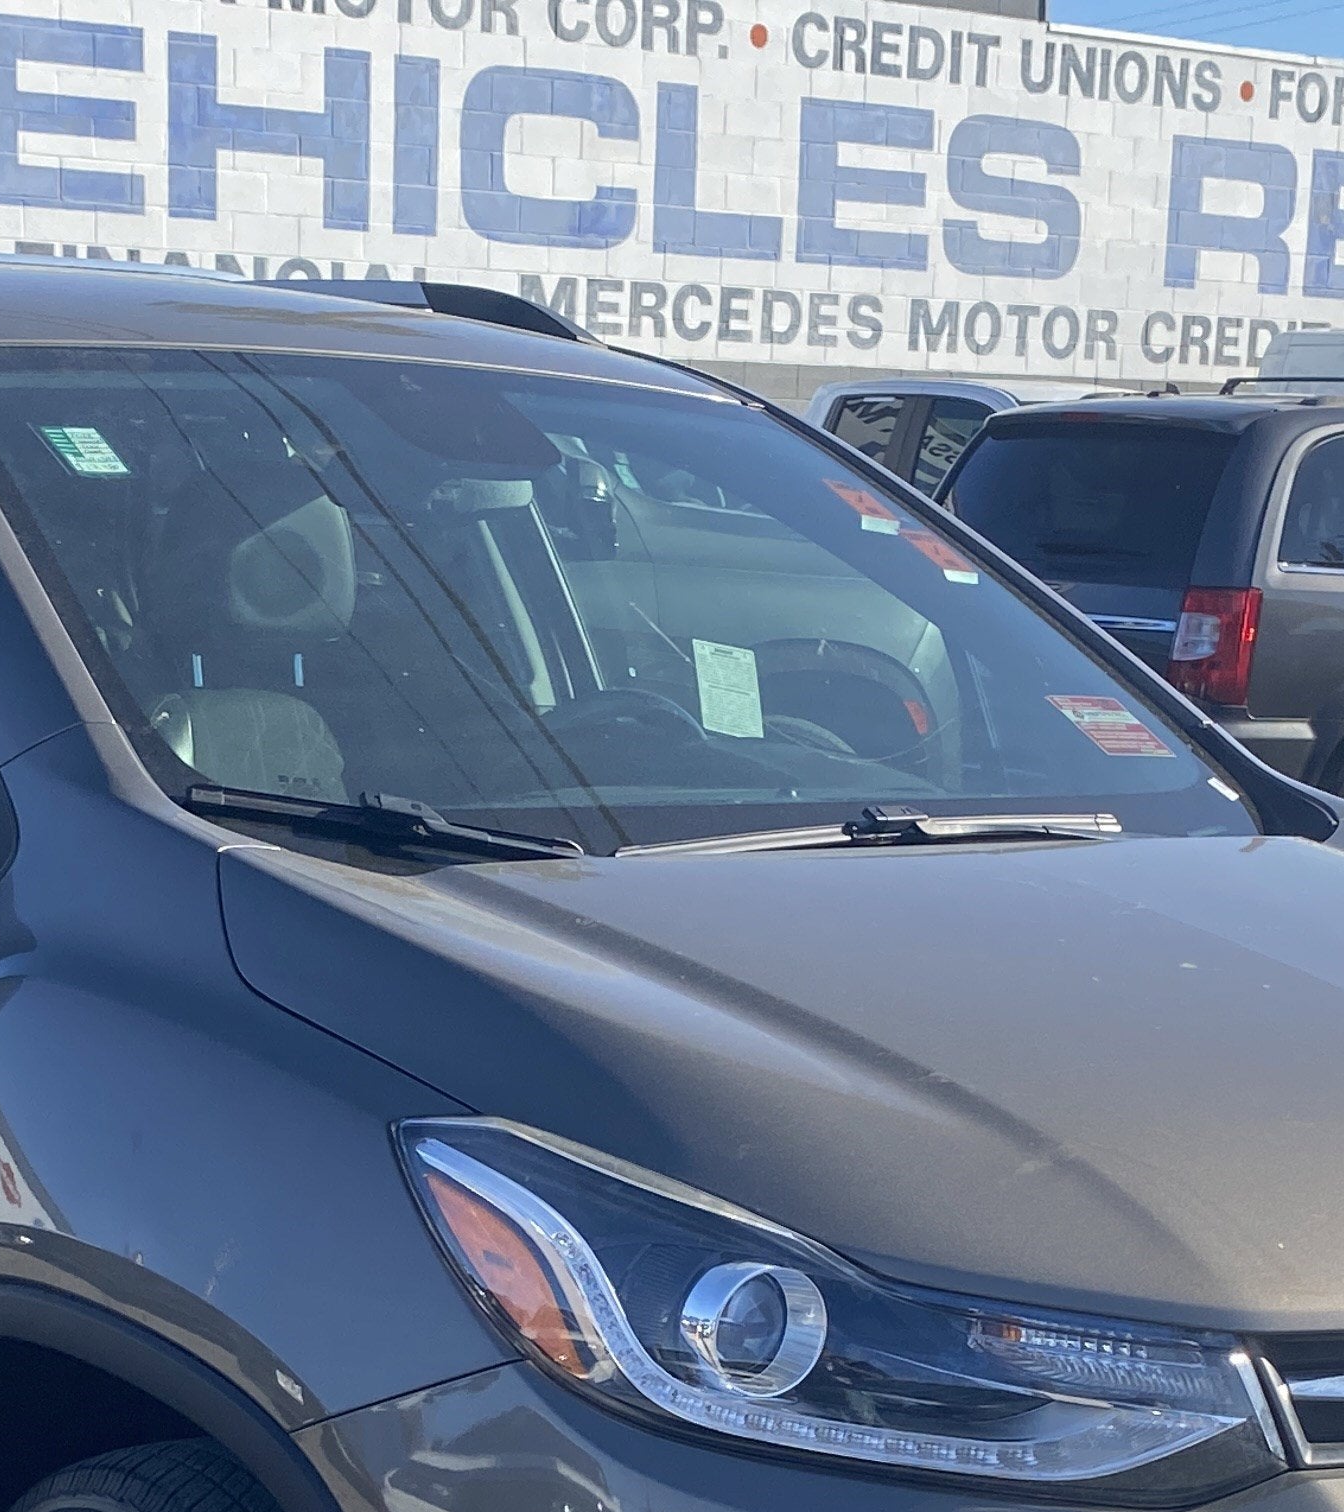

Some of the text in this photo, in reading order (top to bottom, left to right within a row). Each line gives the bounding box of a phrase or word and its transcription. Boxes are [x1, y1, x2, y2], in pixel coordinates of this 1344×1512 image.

[267, 0, 519, 36] TOR
[549, 0, 729, 60] CORP.
[791, 11, 1002, 88] CREDIT
[1020, 38, 1223, 113] UNIONS
[520, 274, 1333, 368] MERCEDES MOTOR CRED
